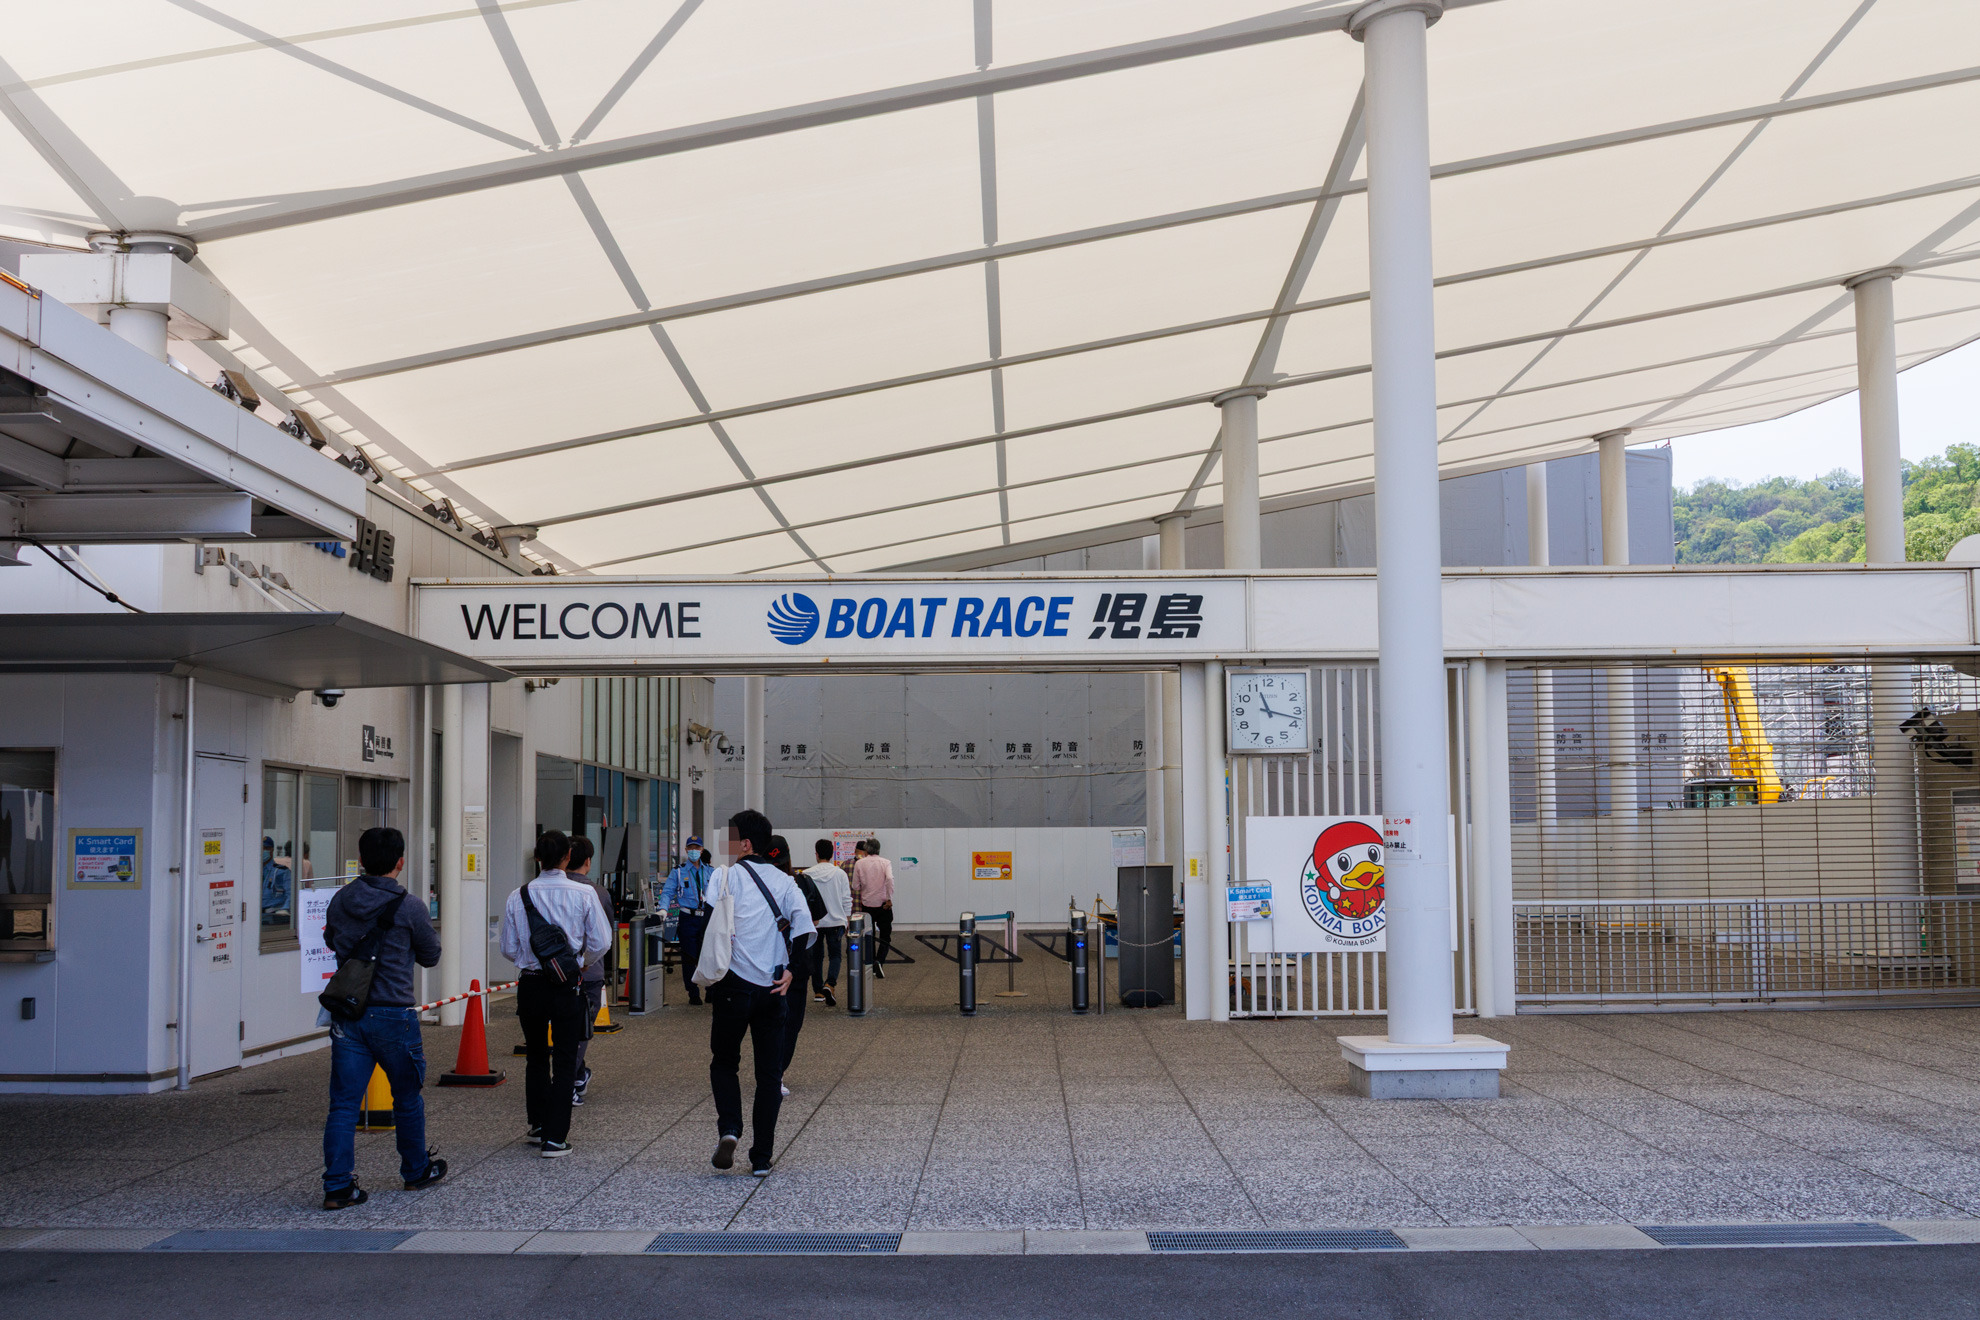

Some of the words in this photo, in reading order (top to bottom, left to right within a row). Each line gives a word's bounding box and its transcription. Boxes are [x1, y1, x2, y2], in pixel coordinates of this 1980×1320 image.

[825, 597, 948, 639] BOAT
[951, 596, 1074, 638] RACE
[1088, 593, 1204, 639] 児島
[460, 602, 701, 640] WELCOME
[1262, 678, 1274, 688] 12
[1281, 682, 1285, 690] 1
[1248, 684, 1258, 692] 11
[1239, 694, 1251, 703] 10
[1289, 693, 1298, 702] 2
[1235, 707, 1245, 716] 9
[1293, 706, 1302, 715] 3
[1240, 721, 1249, 729] 8
[1288, 720, 1299, 728] 4
[1251, 732, 1260, 741] 7
[1279, 731, 1289, 740] 5
[1557, 734, 1583, 744] 防音
[1642, 734, 1667, 744] 防音
[1264, 736, 1274, 745] 6
[781, 744, 807, 754] 防音
[864, 742, 891, 753] 防音
[950, 742, 976, 753] 防音
[1006, 743, 1032, 753] 防音
[1052, 741, 1078, 752] 防音
[86, 837, 111, 845] Smart
[113, 837, 133, 845] Card
[1304, 885, 1342, 933] KOJIMA
[1352, 906, 1386, 934] BOAT
[1360, 935, 1378, 946] BOAT
